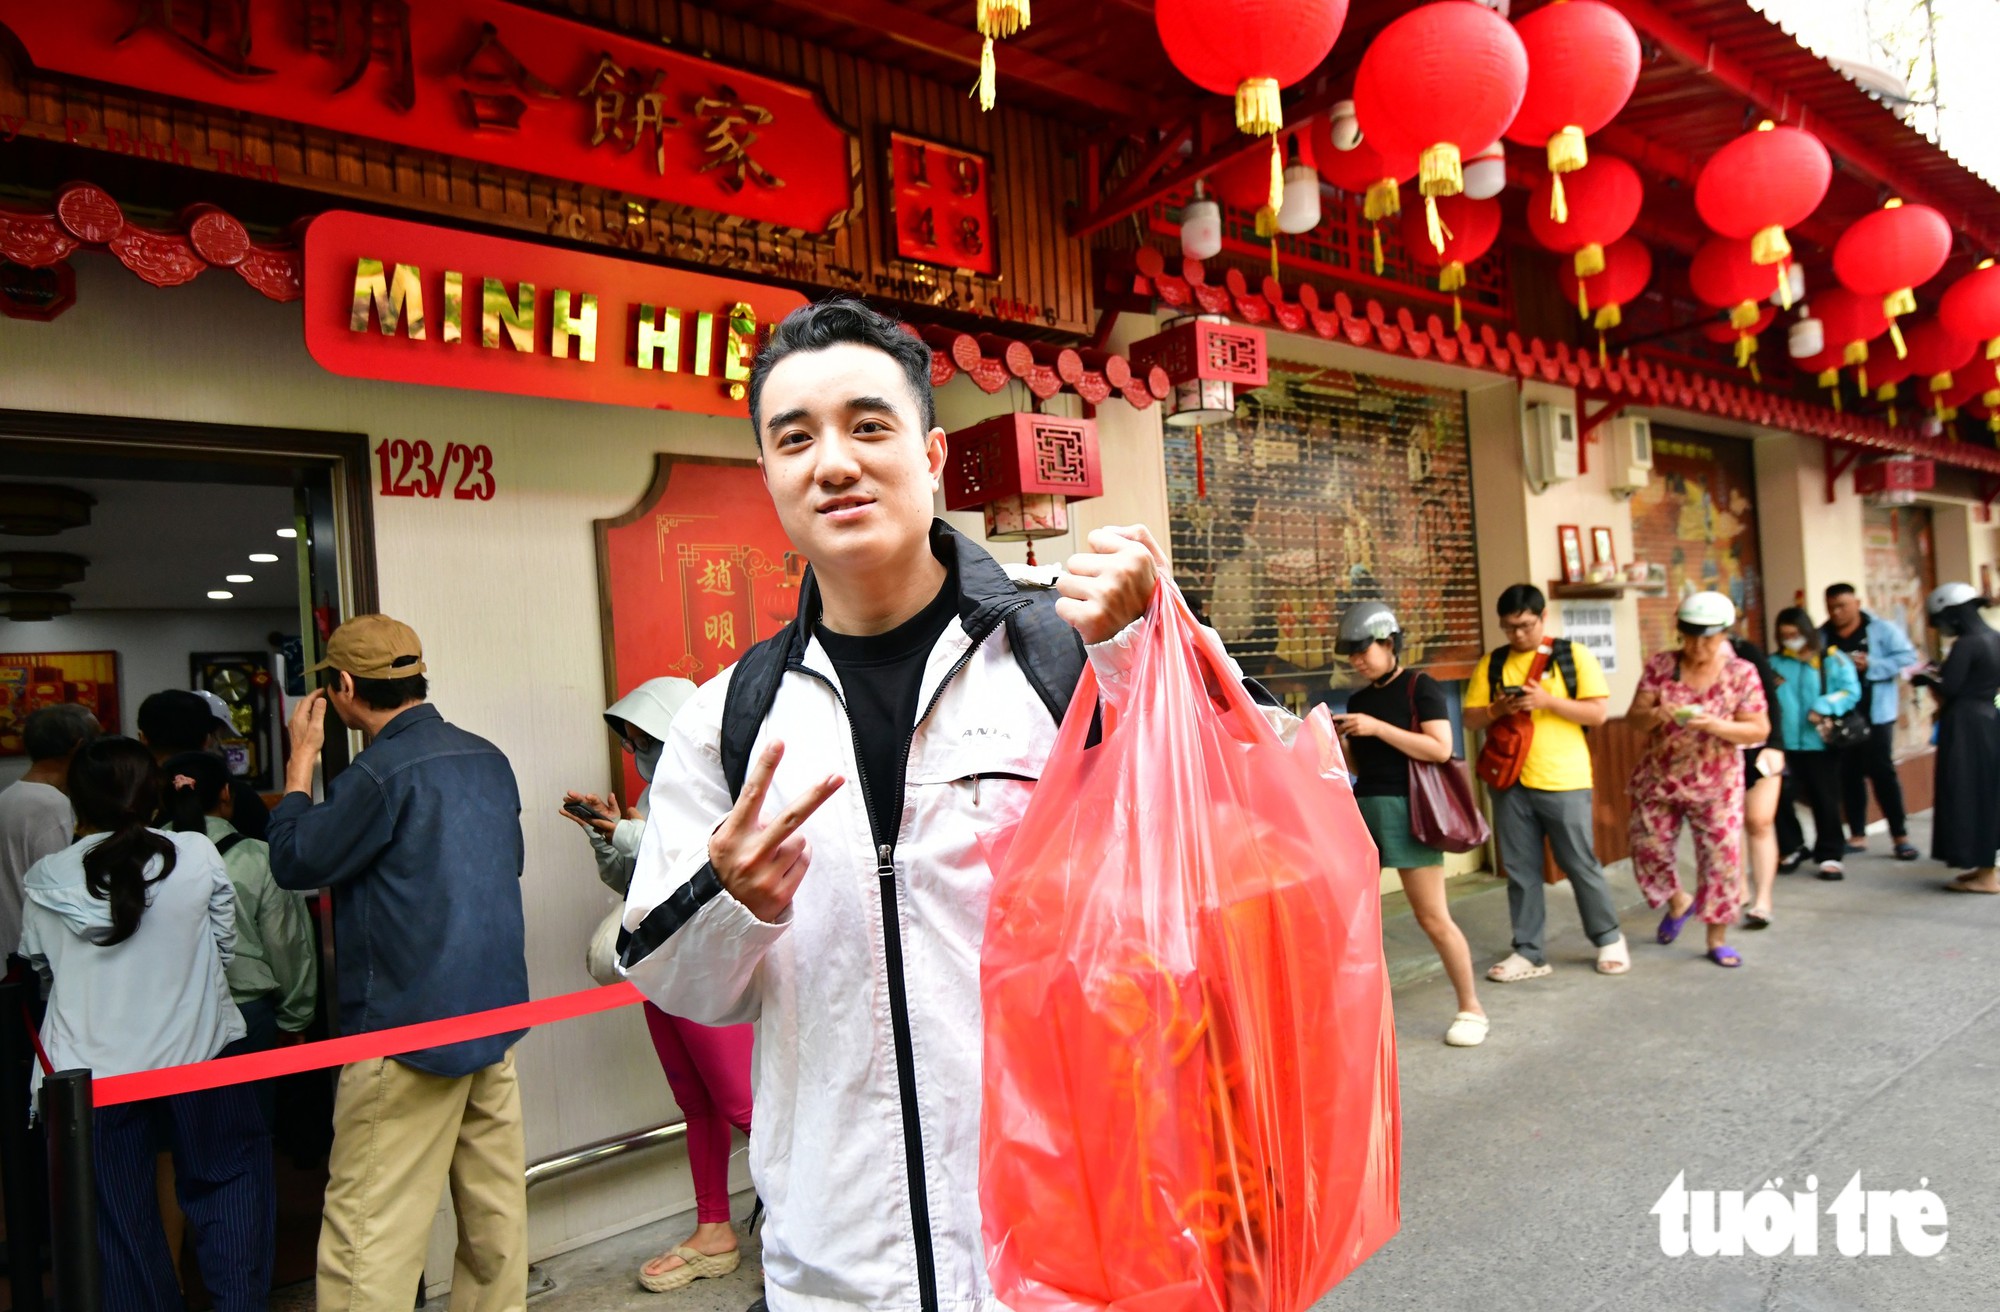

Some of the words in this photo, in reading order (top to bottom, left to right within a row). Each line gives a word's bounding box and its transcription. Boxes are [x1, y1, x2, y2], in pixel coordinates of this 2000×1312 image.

[349, 256, 599, 363] MINH
[637, 301, 776, 401] HIỆ
[375, 437, 496, 502] 123/23
[696, 558, 737, 673] 趙明
